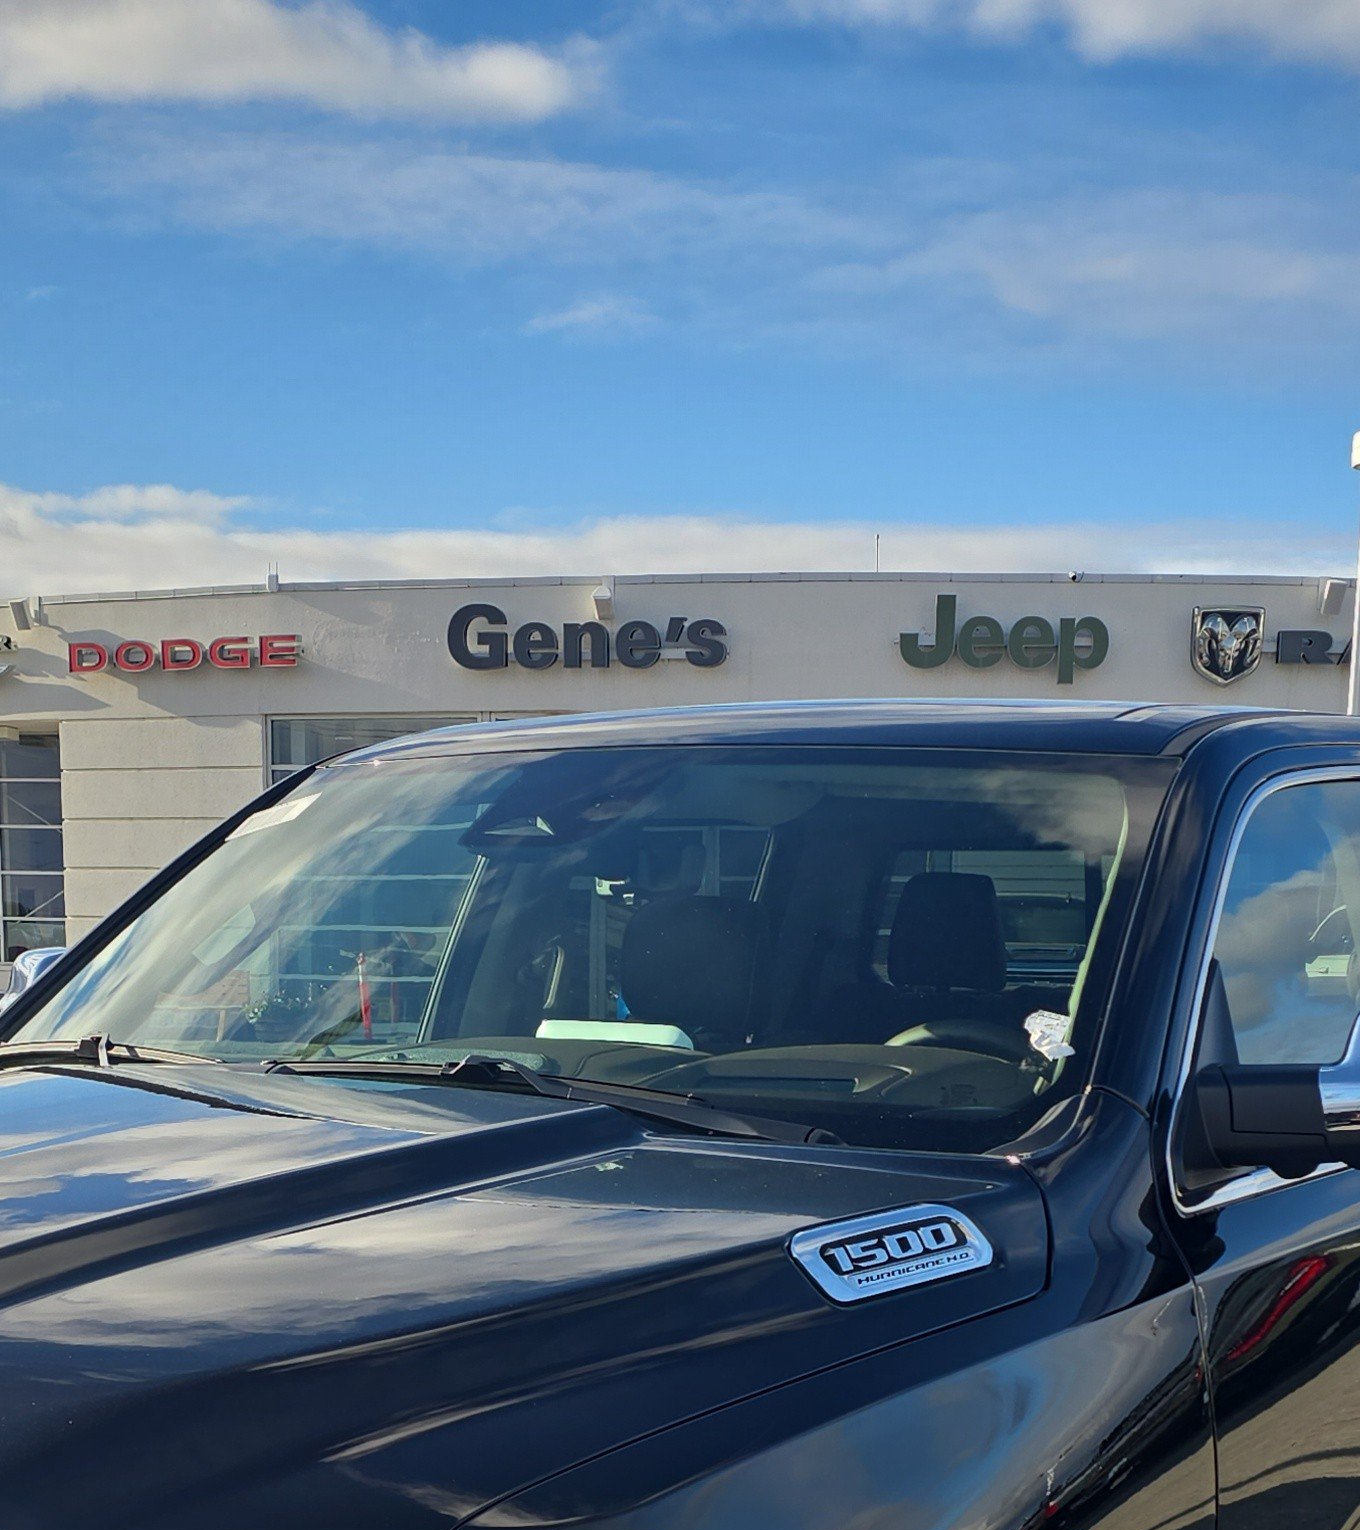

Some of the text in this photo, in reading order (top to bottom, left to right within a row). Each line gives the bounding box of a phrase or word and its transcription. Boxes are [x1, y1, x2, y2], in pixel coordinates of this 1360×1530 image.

[68, 634, 301, 673] DODGE
[447, 603, 728, 671] Gene's
[899, 594, 1109, 685] Jeep
[824, 1222, 958, 1272] 1500
[857, 1258, 945, 1284] HURRICANE
